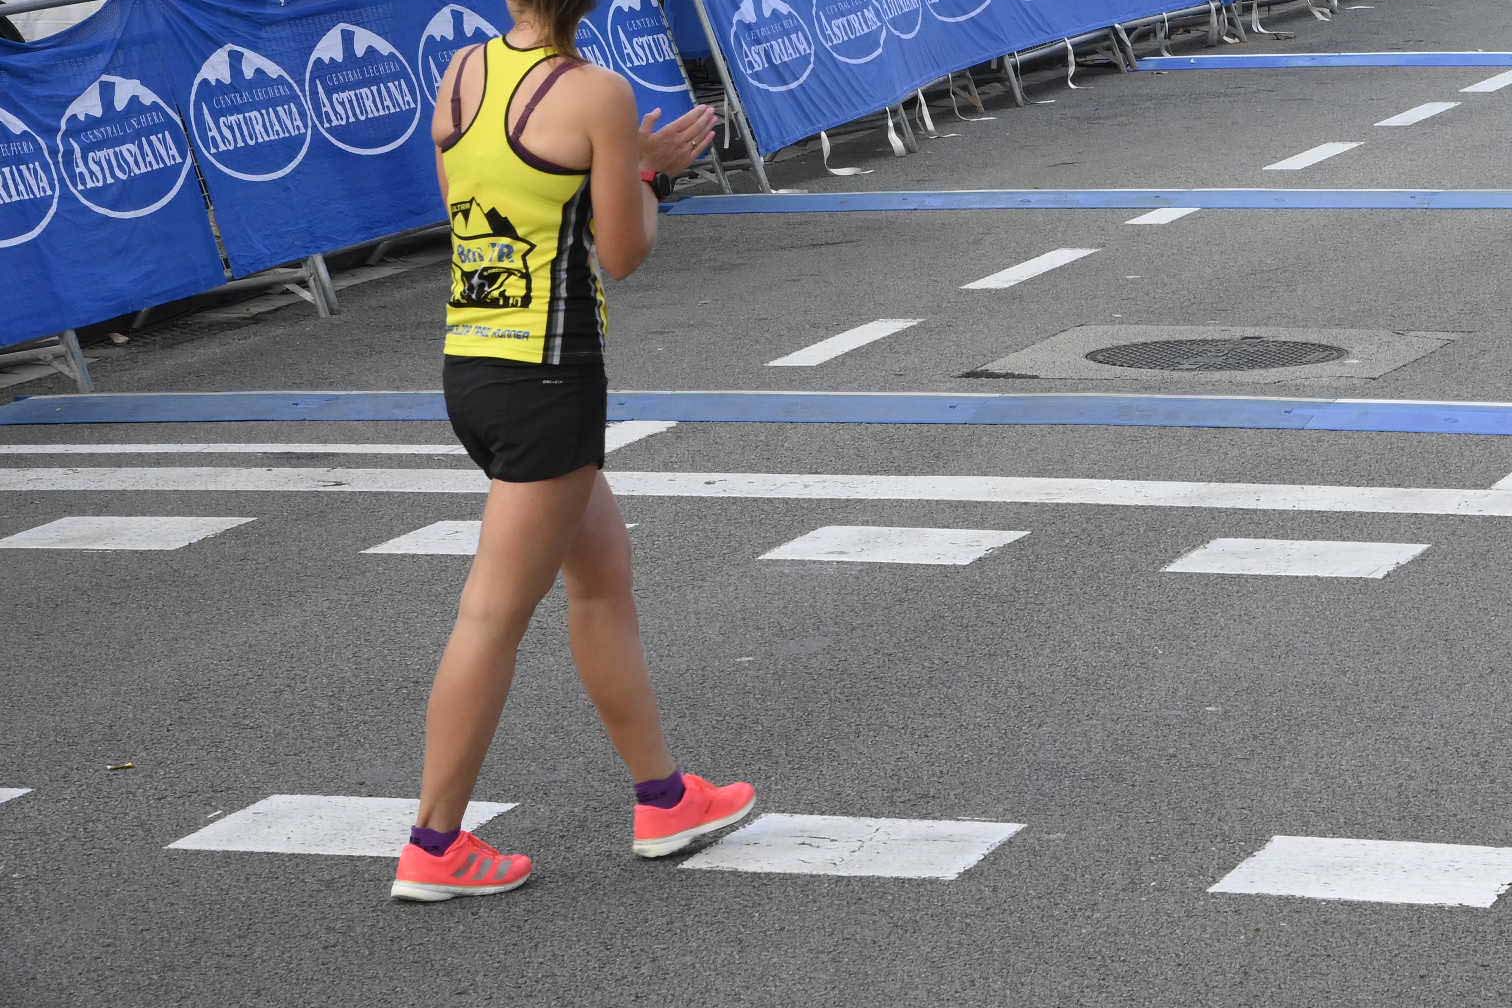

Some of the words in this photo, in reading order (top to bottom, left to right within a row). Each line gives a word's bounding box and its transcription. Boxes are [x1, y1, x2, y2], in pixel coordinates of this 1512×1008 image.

[213, 89, 252, 109] CENTRAL
[253, 84, 290, 101] LECHERA
[326, 69, 362, 86] CENTRAL
[363, 61, 400, 79] LECHERA
[201, 101, 306, 154] ASTURIANA
[315, 78, 416, 129] ASTURIANA
[69, 130, 183, 191] ASTURIANA
